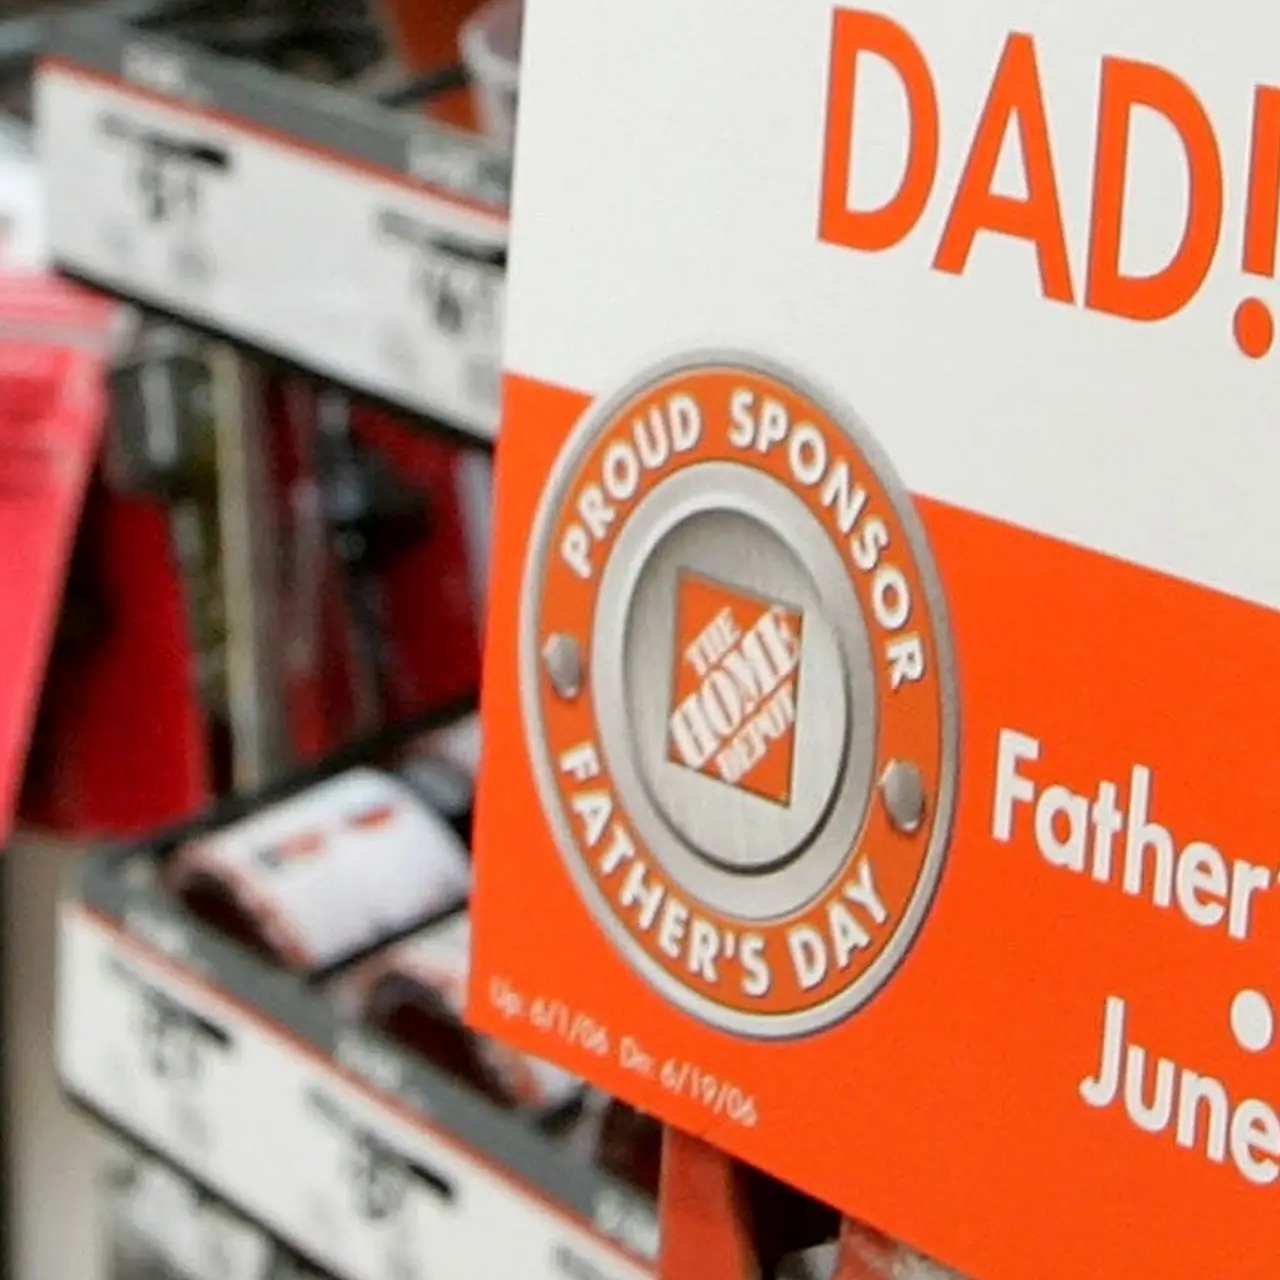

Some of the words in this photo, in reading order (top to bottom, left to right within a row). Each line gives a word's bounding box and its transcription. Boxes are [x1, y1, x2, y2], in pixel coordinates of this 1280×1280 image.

[817, 5, 1280, 360] DAD!
[560, 392, 702, 579] PROUD
[728, 387, 925, 691] SPONSOR
[671, 605, 801, 769] HOME
[683, 605, 743, 679] THE
[560, 740, 771, 997] FATHER'S
[786, 852, 888, 992] DAY
[992, 727, 1280, 941] Father
[659, 1057, 758, 1128] 6/19/06
[1078, 995, 1280, 1185] June
